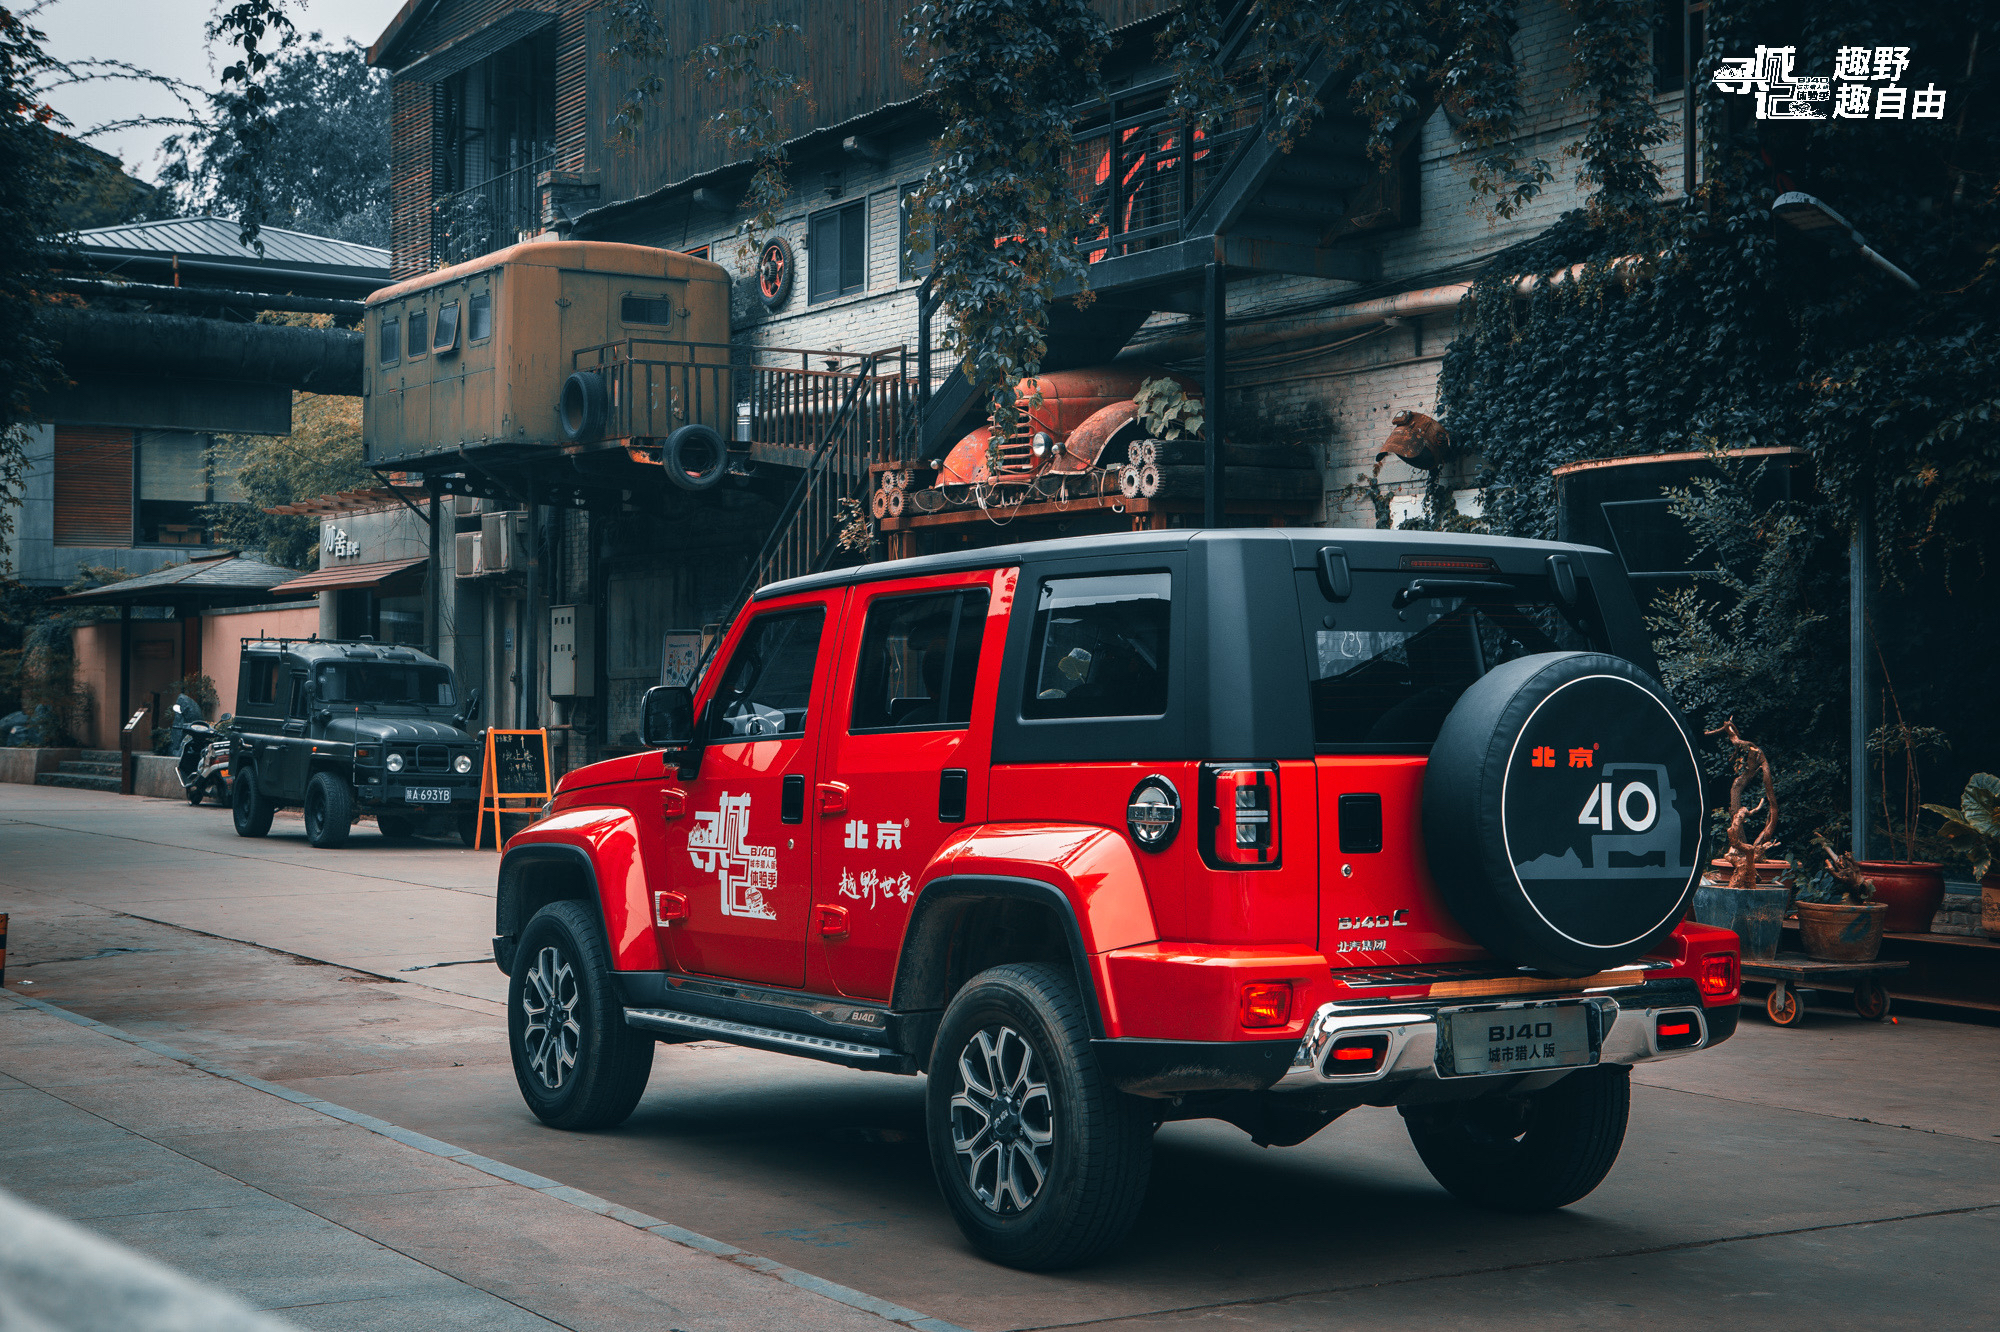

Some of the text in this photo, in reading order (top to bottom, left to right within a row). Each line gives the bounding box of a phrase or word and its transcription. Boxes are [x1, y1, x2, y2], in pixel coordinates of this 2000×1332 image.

[1531, 745, 1594, 769] 北京
[1578, 781, 1657, 832] 40
[844, 819, 903, 850] 北京
[750, 847, 776, 858] BJ40
[750, 870, 777, 888] 体验季
[838, 866, 914, 911] 越野世家
[1336, 939, 1387, 953] 北汽集团
[851, 1011, 875, 1023] BJ40
[1488, 1021, 1552, 1042] BJ40
[1488, 1042, 1556, 1064] 城市猎人版
